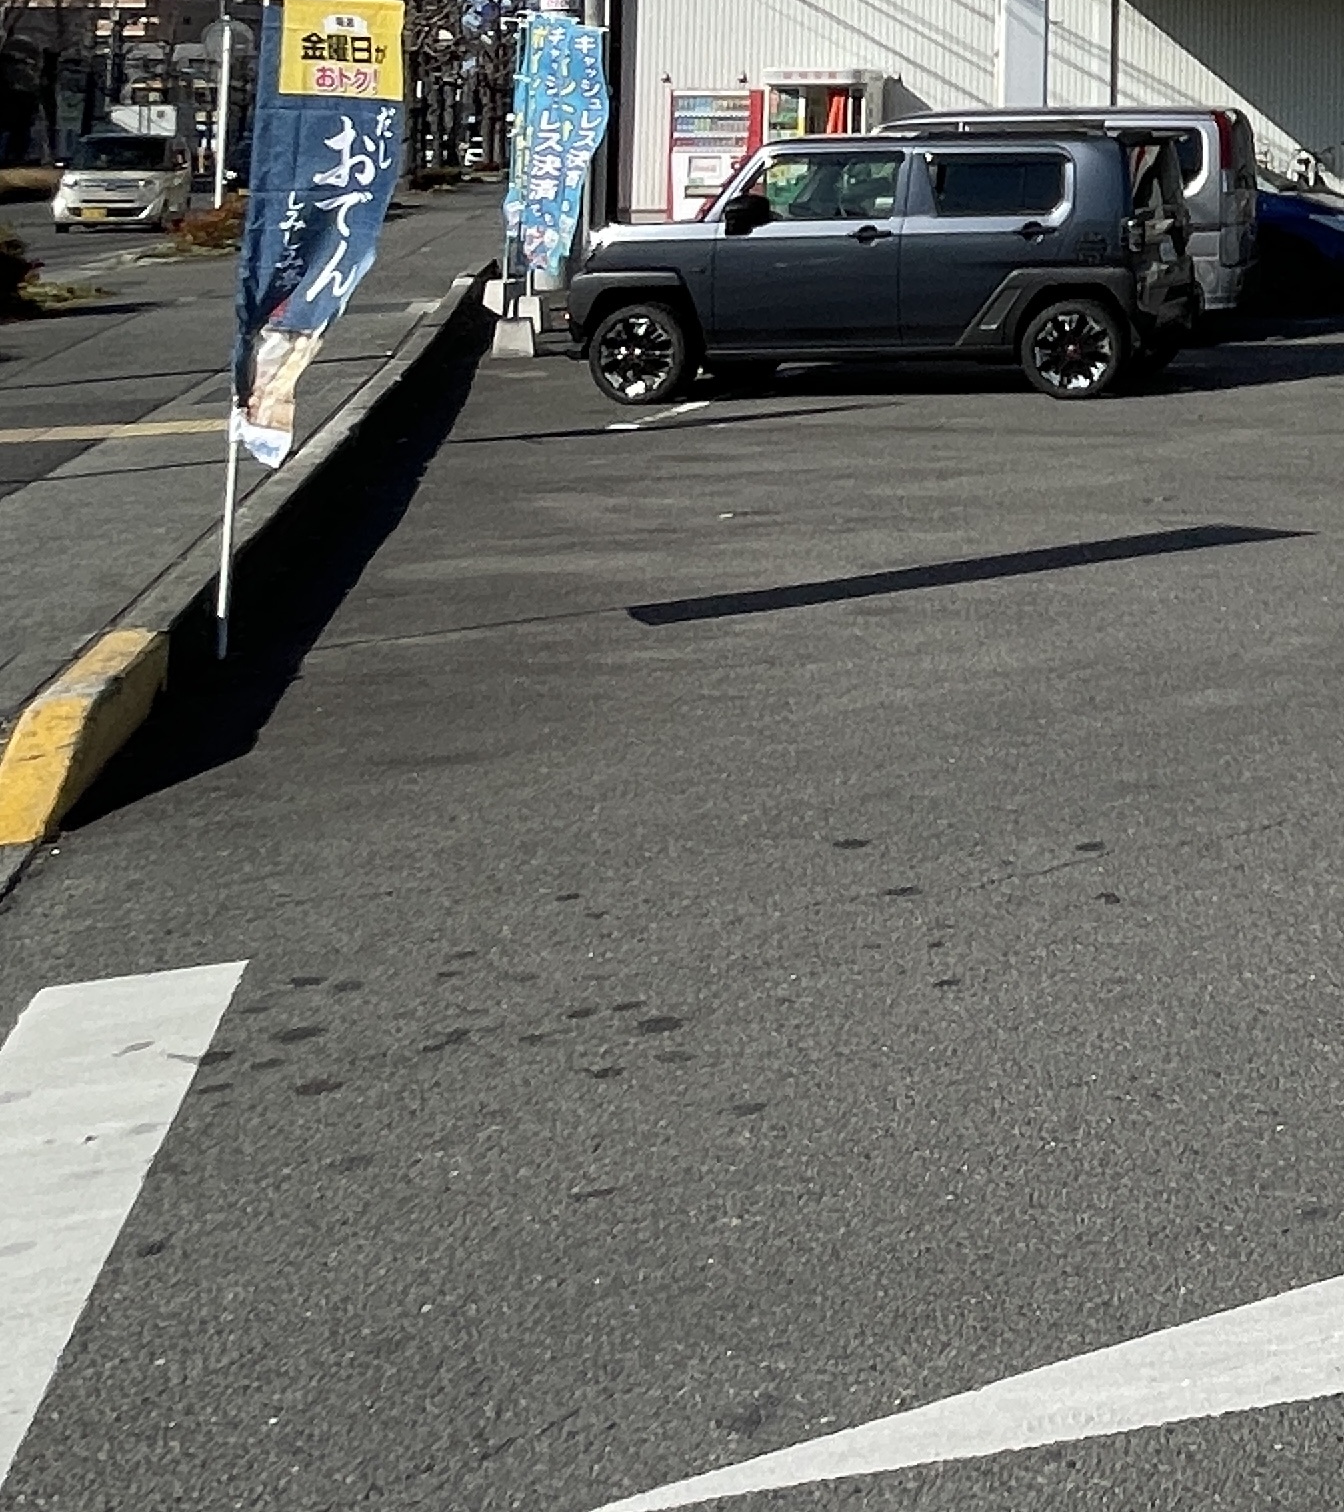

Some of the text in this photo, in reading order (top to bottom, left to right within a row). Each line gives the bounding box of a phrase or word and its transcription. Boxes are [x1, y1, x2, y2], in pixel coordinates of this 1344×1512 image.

[301, 32, 387, 64] 金曜日が
[307, 115, 375, 302] おでん
